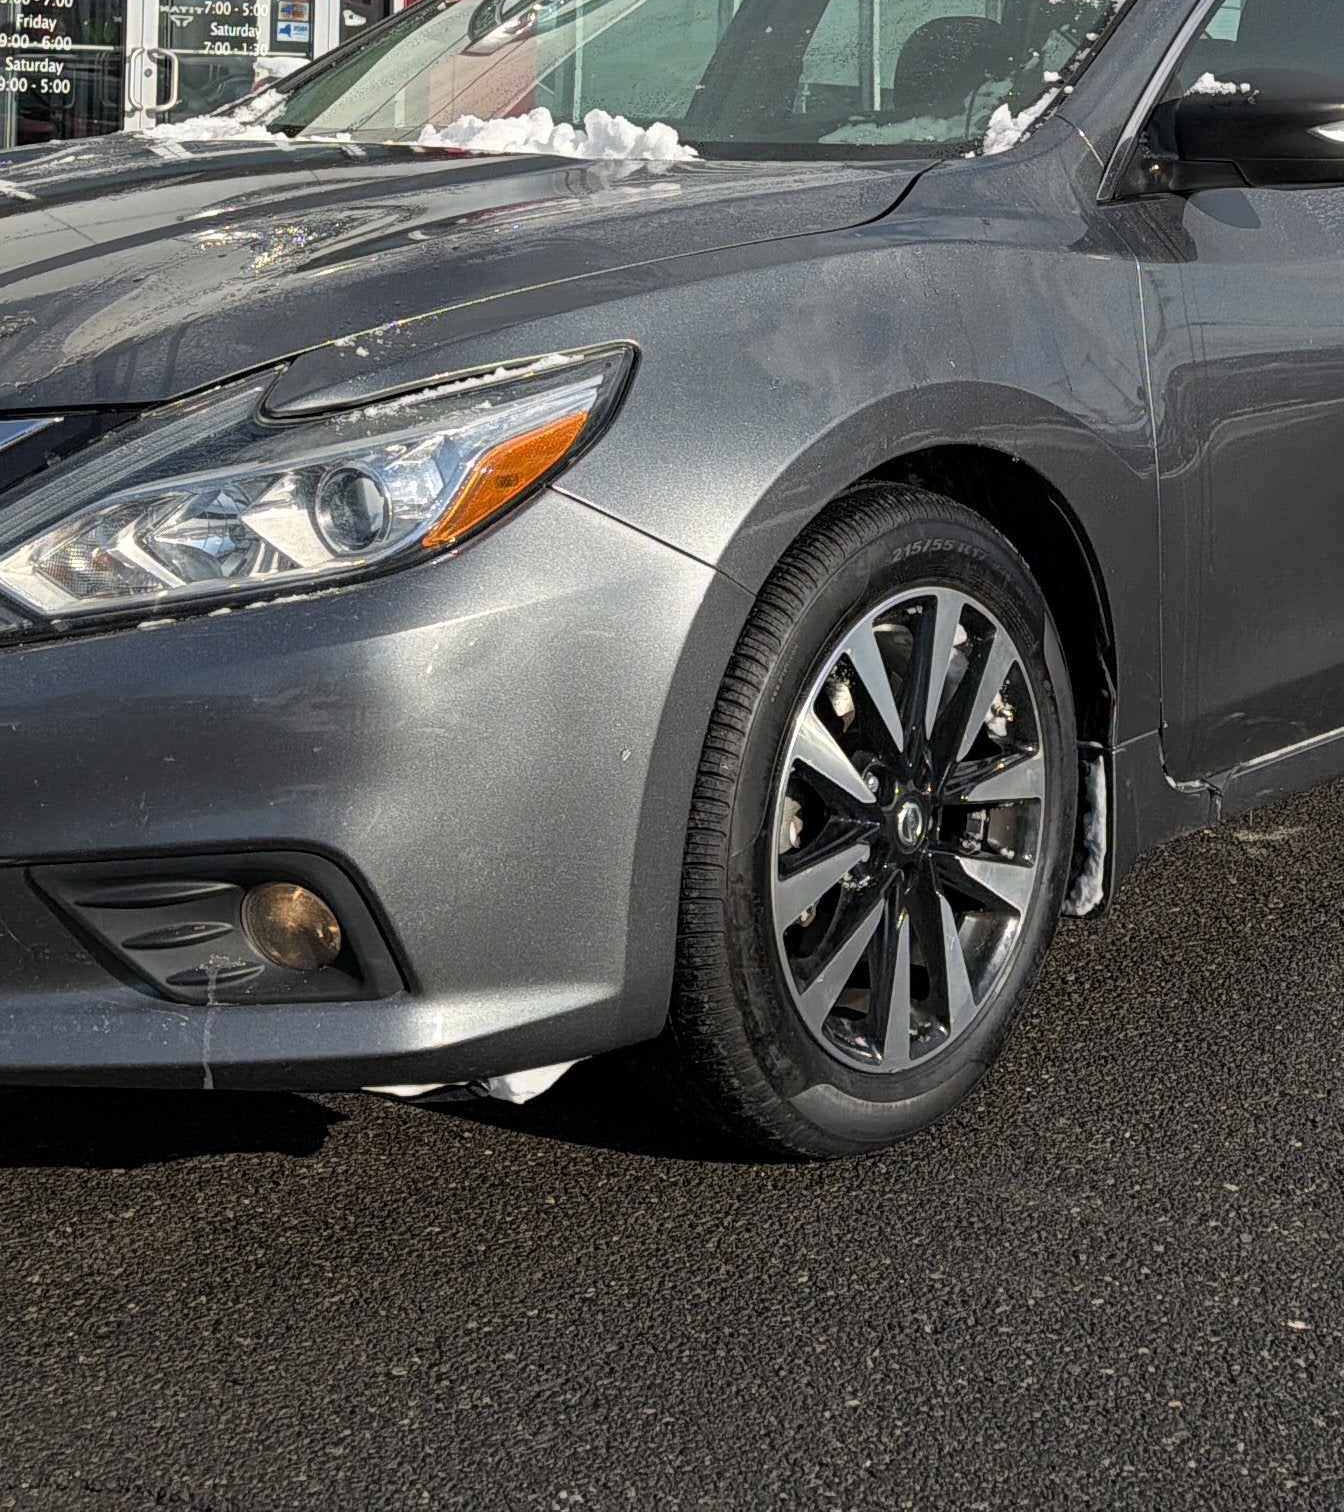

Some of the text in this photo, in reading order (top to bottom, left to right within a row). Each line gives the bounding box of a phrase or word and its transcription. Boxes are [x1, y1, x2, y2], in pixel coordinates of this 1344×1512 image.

[204, 1, 232, 15] 7:00
[242, 2, 269, 17] 5:00
[15, 13, 58, 33] Friday
[210, 21, 262, 40] Saturday
[41, 36, 72, 51] 6:00
[204, 41, 231, 55] 7:00
[242, 42, 268, 56] 1:30
[5, 56, 64, 75] Saturday
[40, 79, 71, 94] 5:00
[891, 539, 956, 564] 215/55
